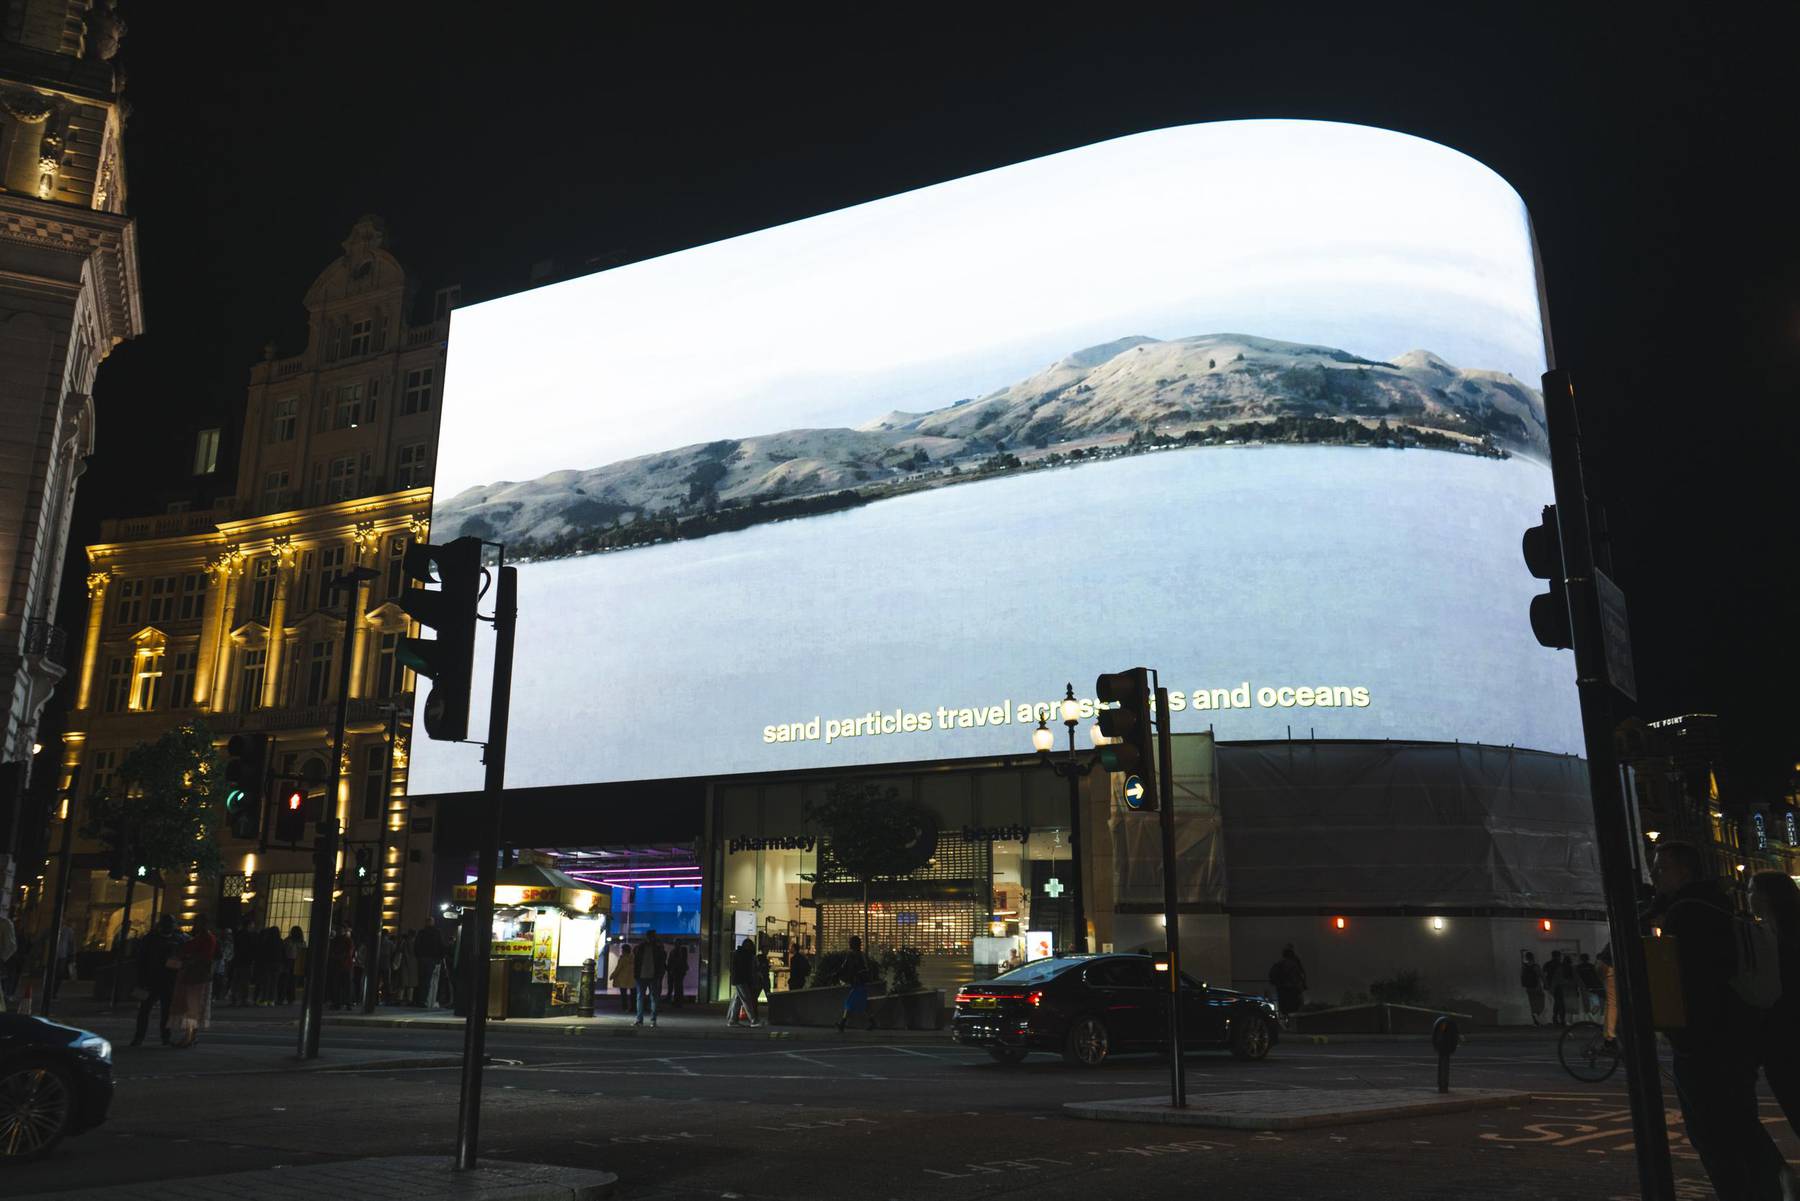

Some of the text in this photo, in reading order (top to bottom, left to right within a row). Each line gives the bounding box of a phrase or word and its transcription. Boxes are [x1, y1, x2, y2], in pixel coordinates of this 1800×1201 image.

[762, 716, 821, 744] sand
[825, 708, 934, 745] particles
[936, 698, 1012, 729] travel
[1016, 696, 1111, 724] acrs
[1192, 681, 1252, 710] and
[1256, 685, 1371, 708] oceans
[729, 834, 817, 855] pharmacy
[521, 888, 558, 900] SPOT
